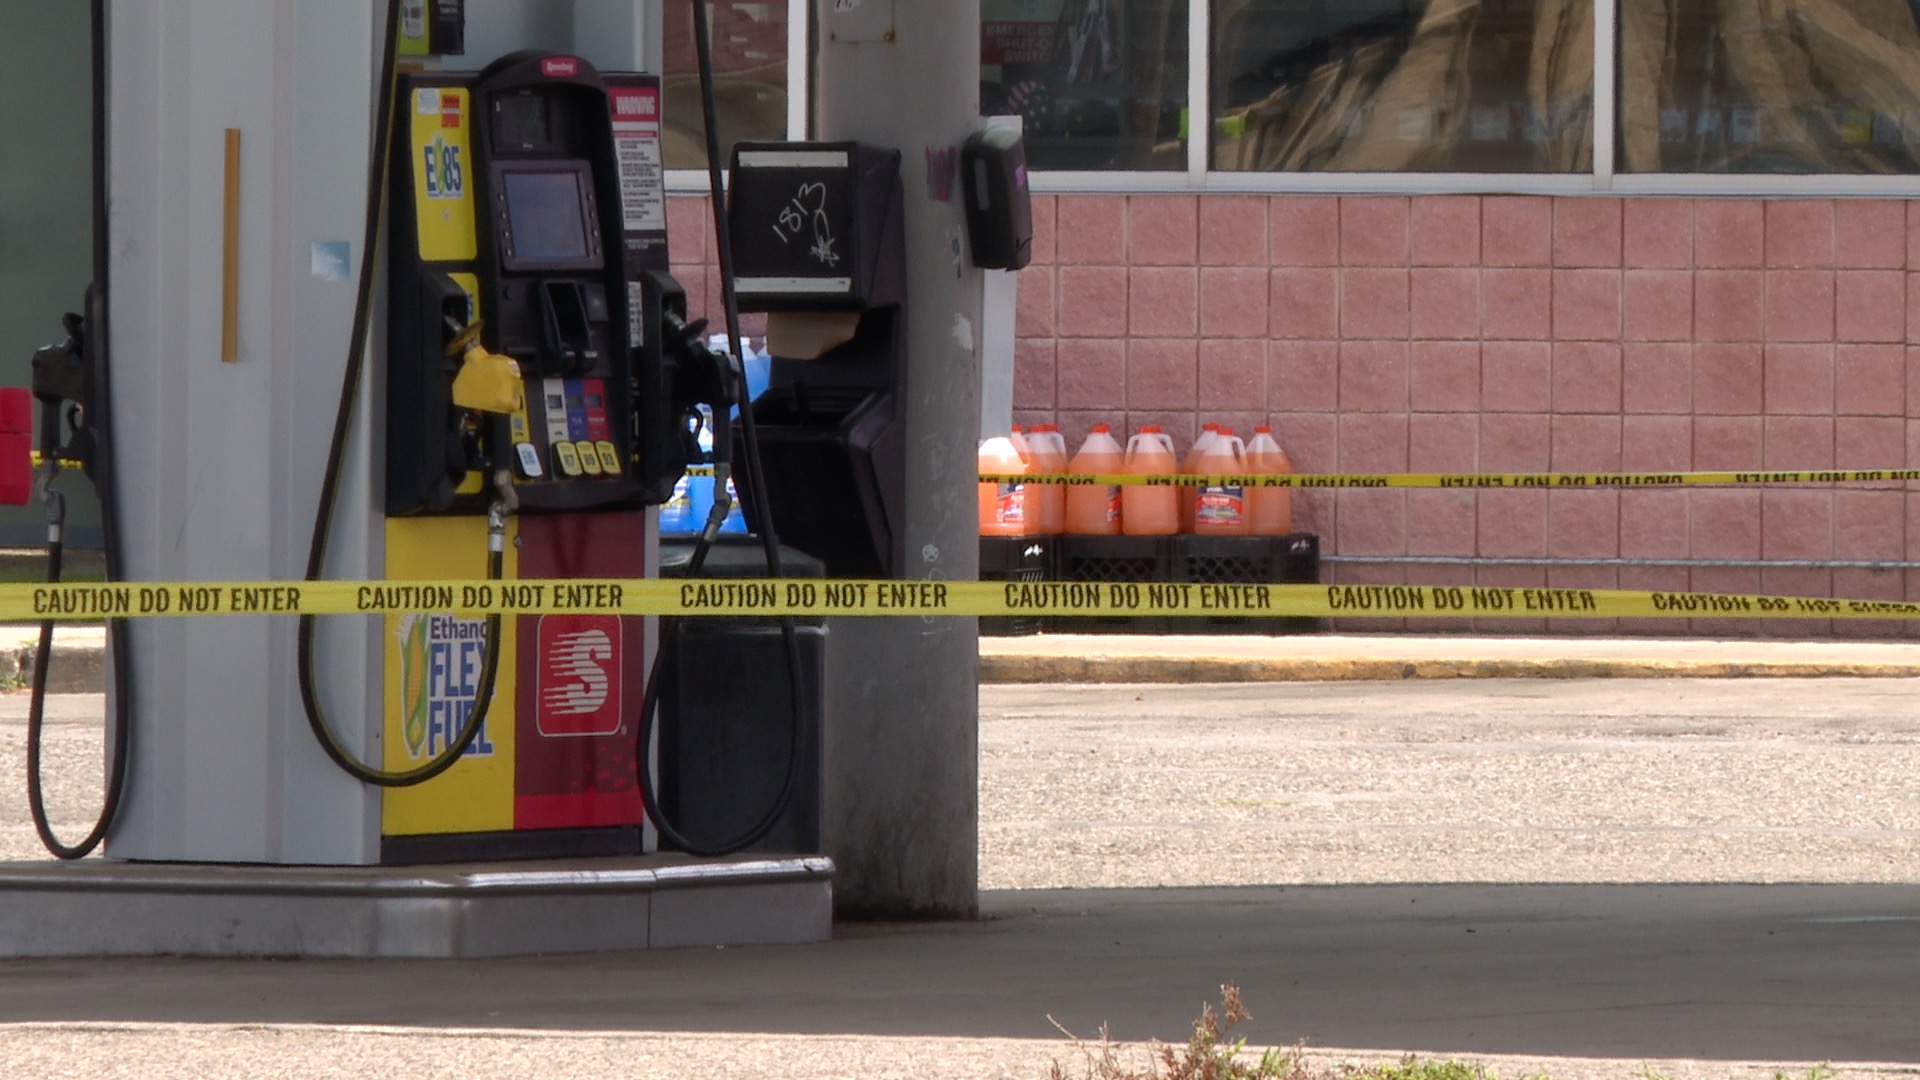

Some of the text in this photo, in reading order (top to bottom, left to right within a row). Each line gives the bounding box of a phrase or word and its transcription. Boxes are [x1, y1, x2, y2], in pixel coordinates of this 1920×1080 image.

[616, 95, 655, 115] WARNING
[34, 586, 300, 613] CAUTION DO NOT ENTER
[358, 584, 623, 610] CAUTION DO NOT ENTER
[680, 583, 947, 608] CAUTION DO NOT ENTER
[1004, 583, 1270, 609] CAUTION DO NOT ENTER
[1328, 586, 1596, 610] CAUTION DO NOT ENTER
[1651, 593, 1750, 611] CAUTION
